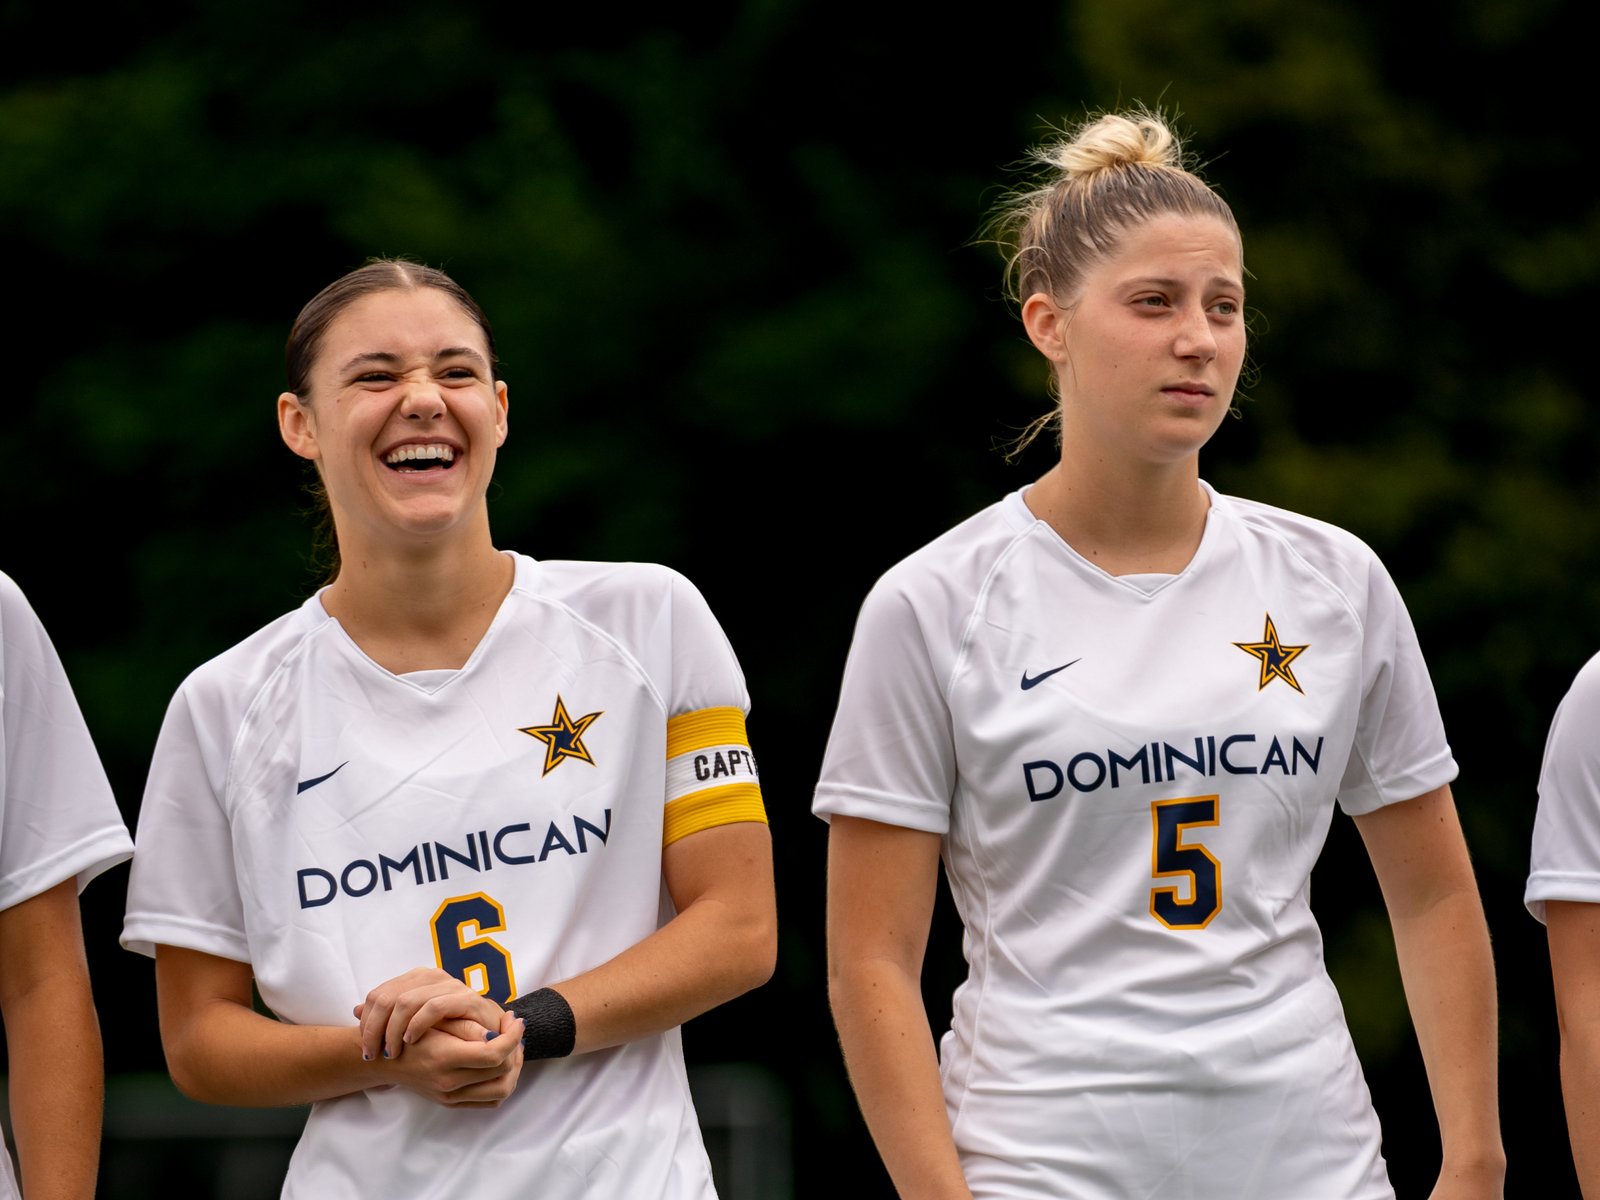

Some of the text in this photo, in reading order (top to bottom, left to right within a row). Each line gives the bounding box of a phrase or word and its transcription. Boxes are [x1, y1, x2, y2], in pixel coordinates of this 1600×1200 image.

[1023, 733, 1324, 803] DOMINICAN
[296, 808, 612, 910] DOMINICAN
[1149, 794, 1223, 931] 5
[429, 890, 517, 1005] 6
